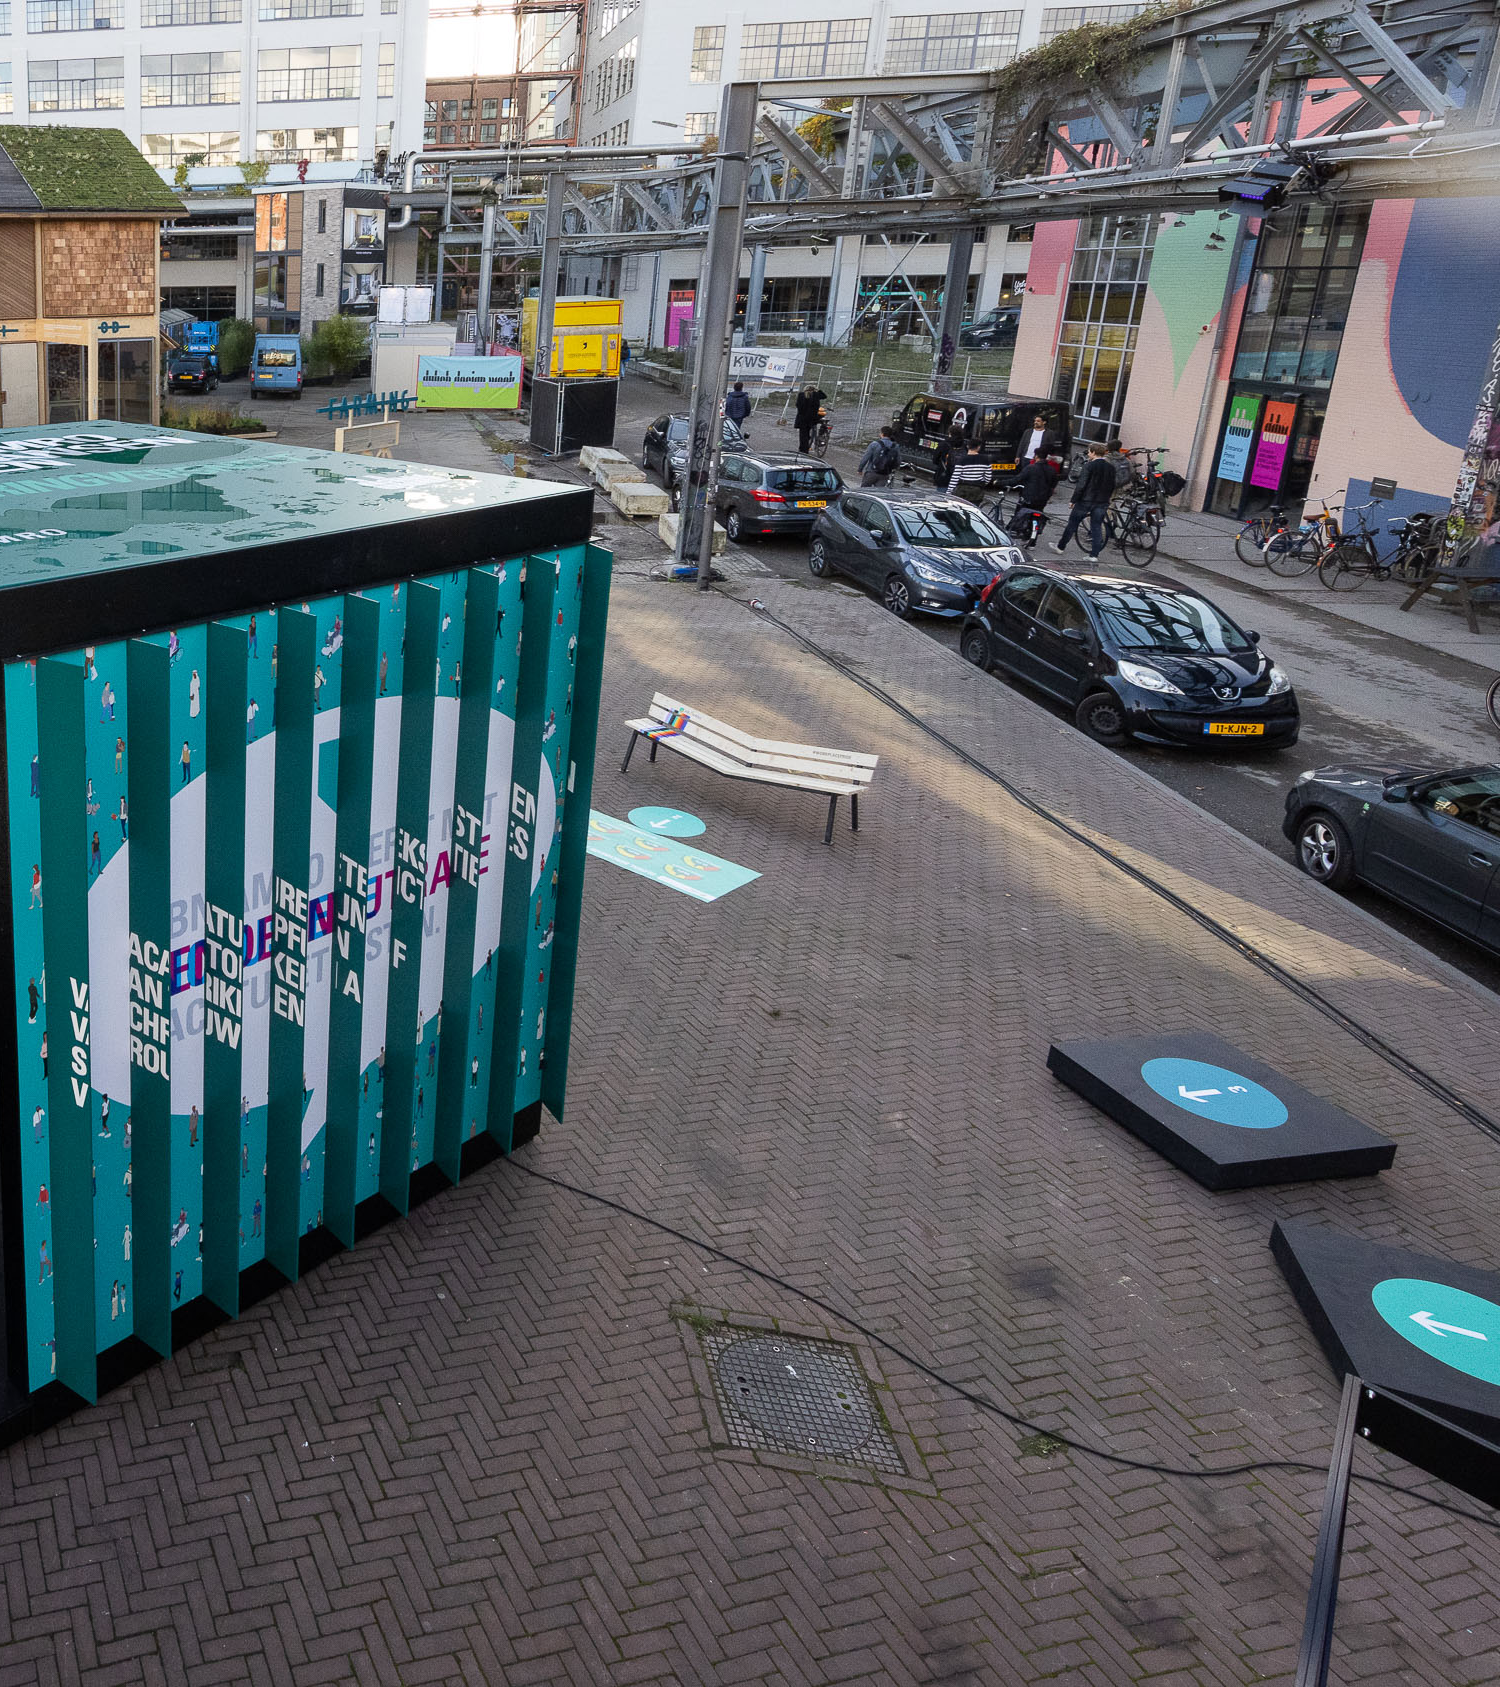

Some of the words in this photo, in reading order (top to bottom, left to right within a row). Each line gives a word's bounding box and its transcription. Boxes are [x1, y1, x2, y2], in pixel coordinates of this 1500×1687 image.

[733, 354, 768, 368] KWS
[772, 364, 786, 373] KWS
[327, 389, 409, 421] FARMING
[1215, 724, 1258, 734] 11-KJN-2
